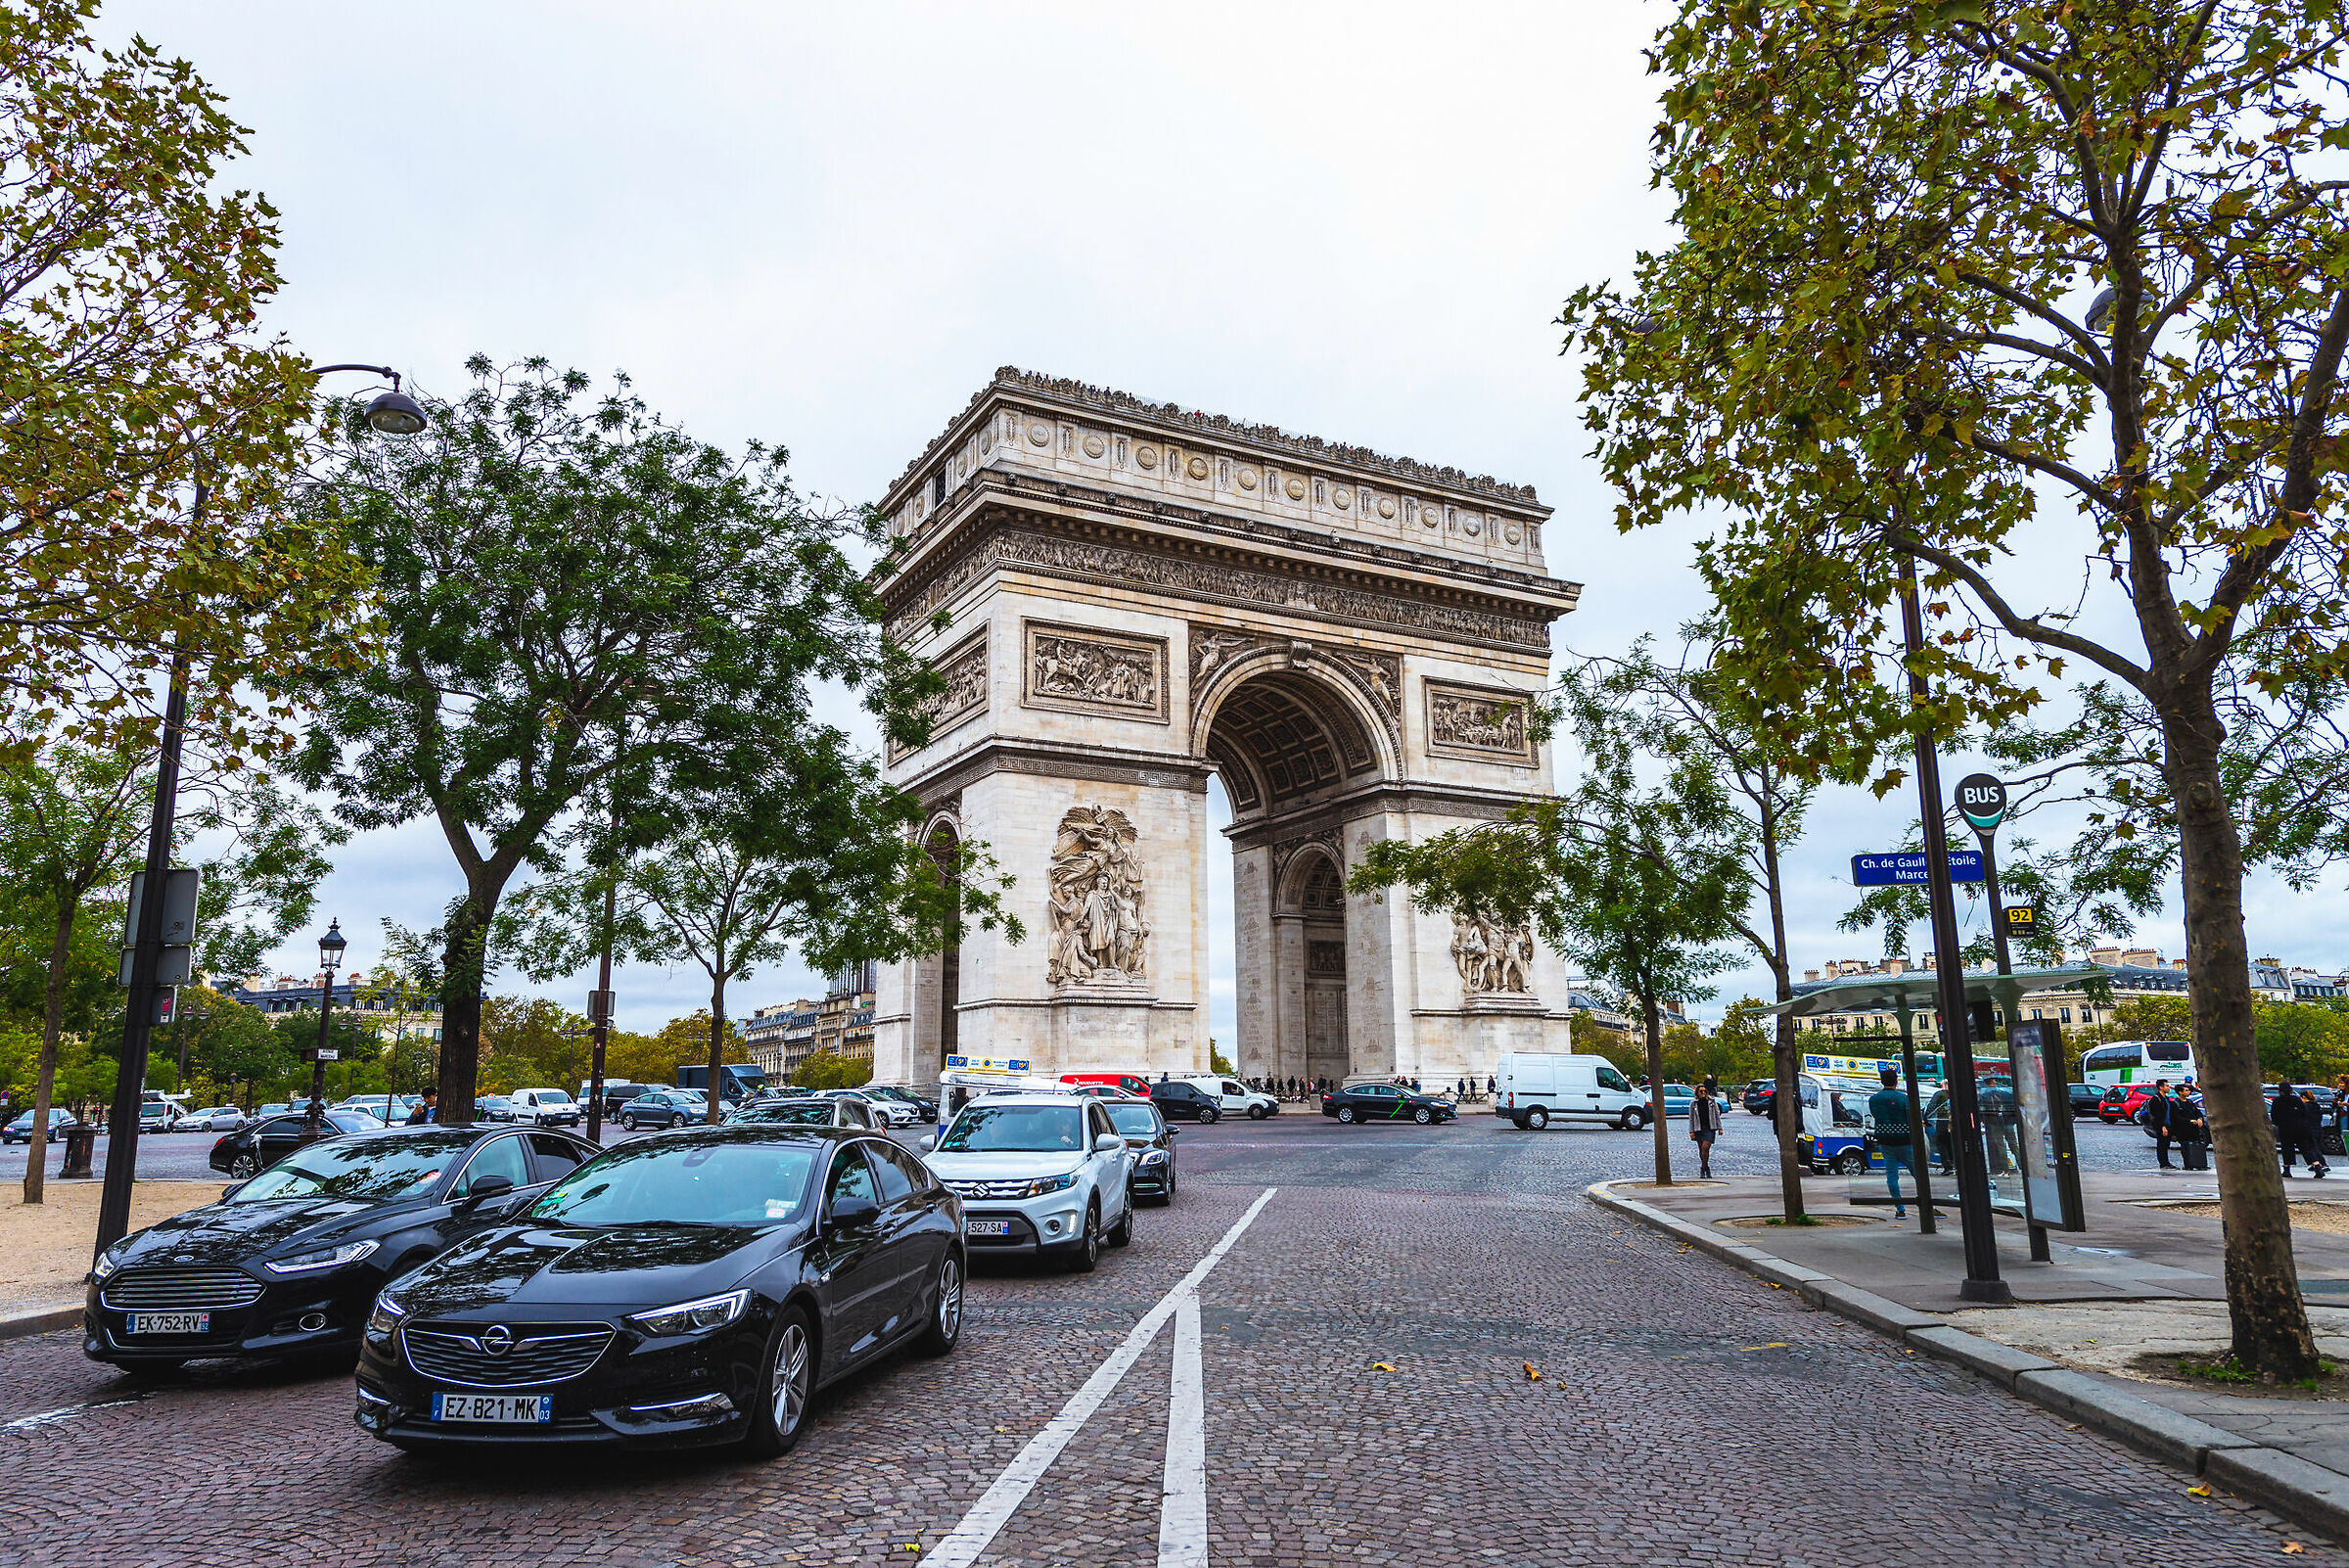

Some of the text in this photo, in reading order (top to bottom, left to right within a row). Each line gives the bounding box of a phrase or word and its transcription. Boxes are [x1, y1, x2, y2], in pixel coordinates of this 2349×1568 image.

[1963, 786, 2000, 805] BUS
[1861, 858, 1879, 869] Ch.
[1881, 857, 1895, 868] de
[1897, 856, 1926, 867] Gaull
[1895, 869, 1929, 880] Marce
[2011, 909, 2030, 922] 92
[968, 1222, 1002, 1233] -527-SA
[137, 1314, 201, 1331] EK-752-RV
[444, 1397, 538, 1420] EZ-821-MK
[539, 1409, 550, 1420] 03
